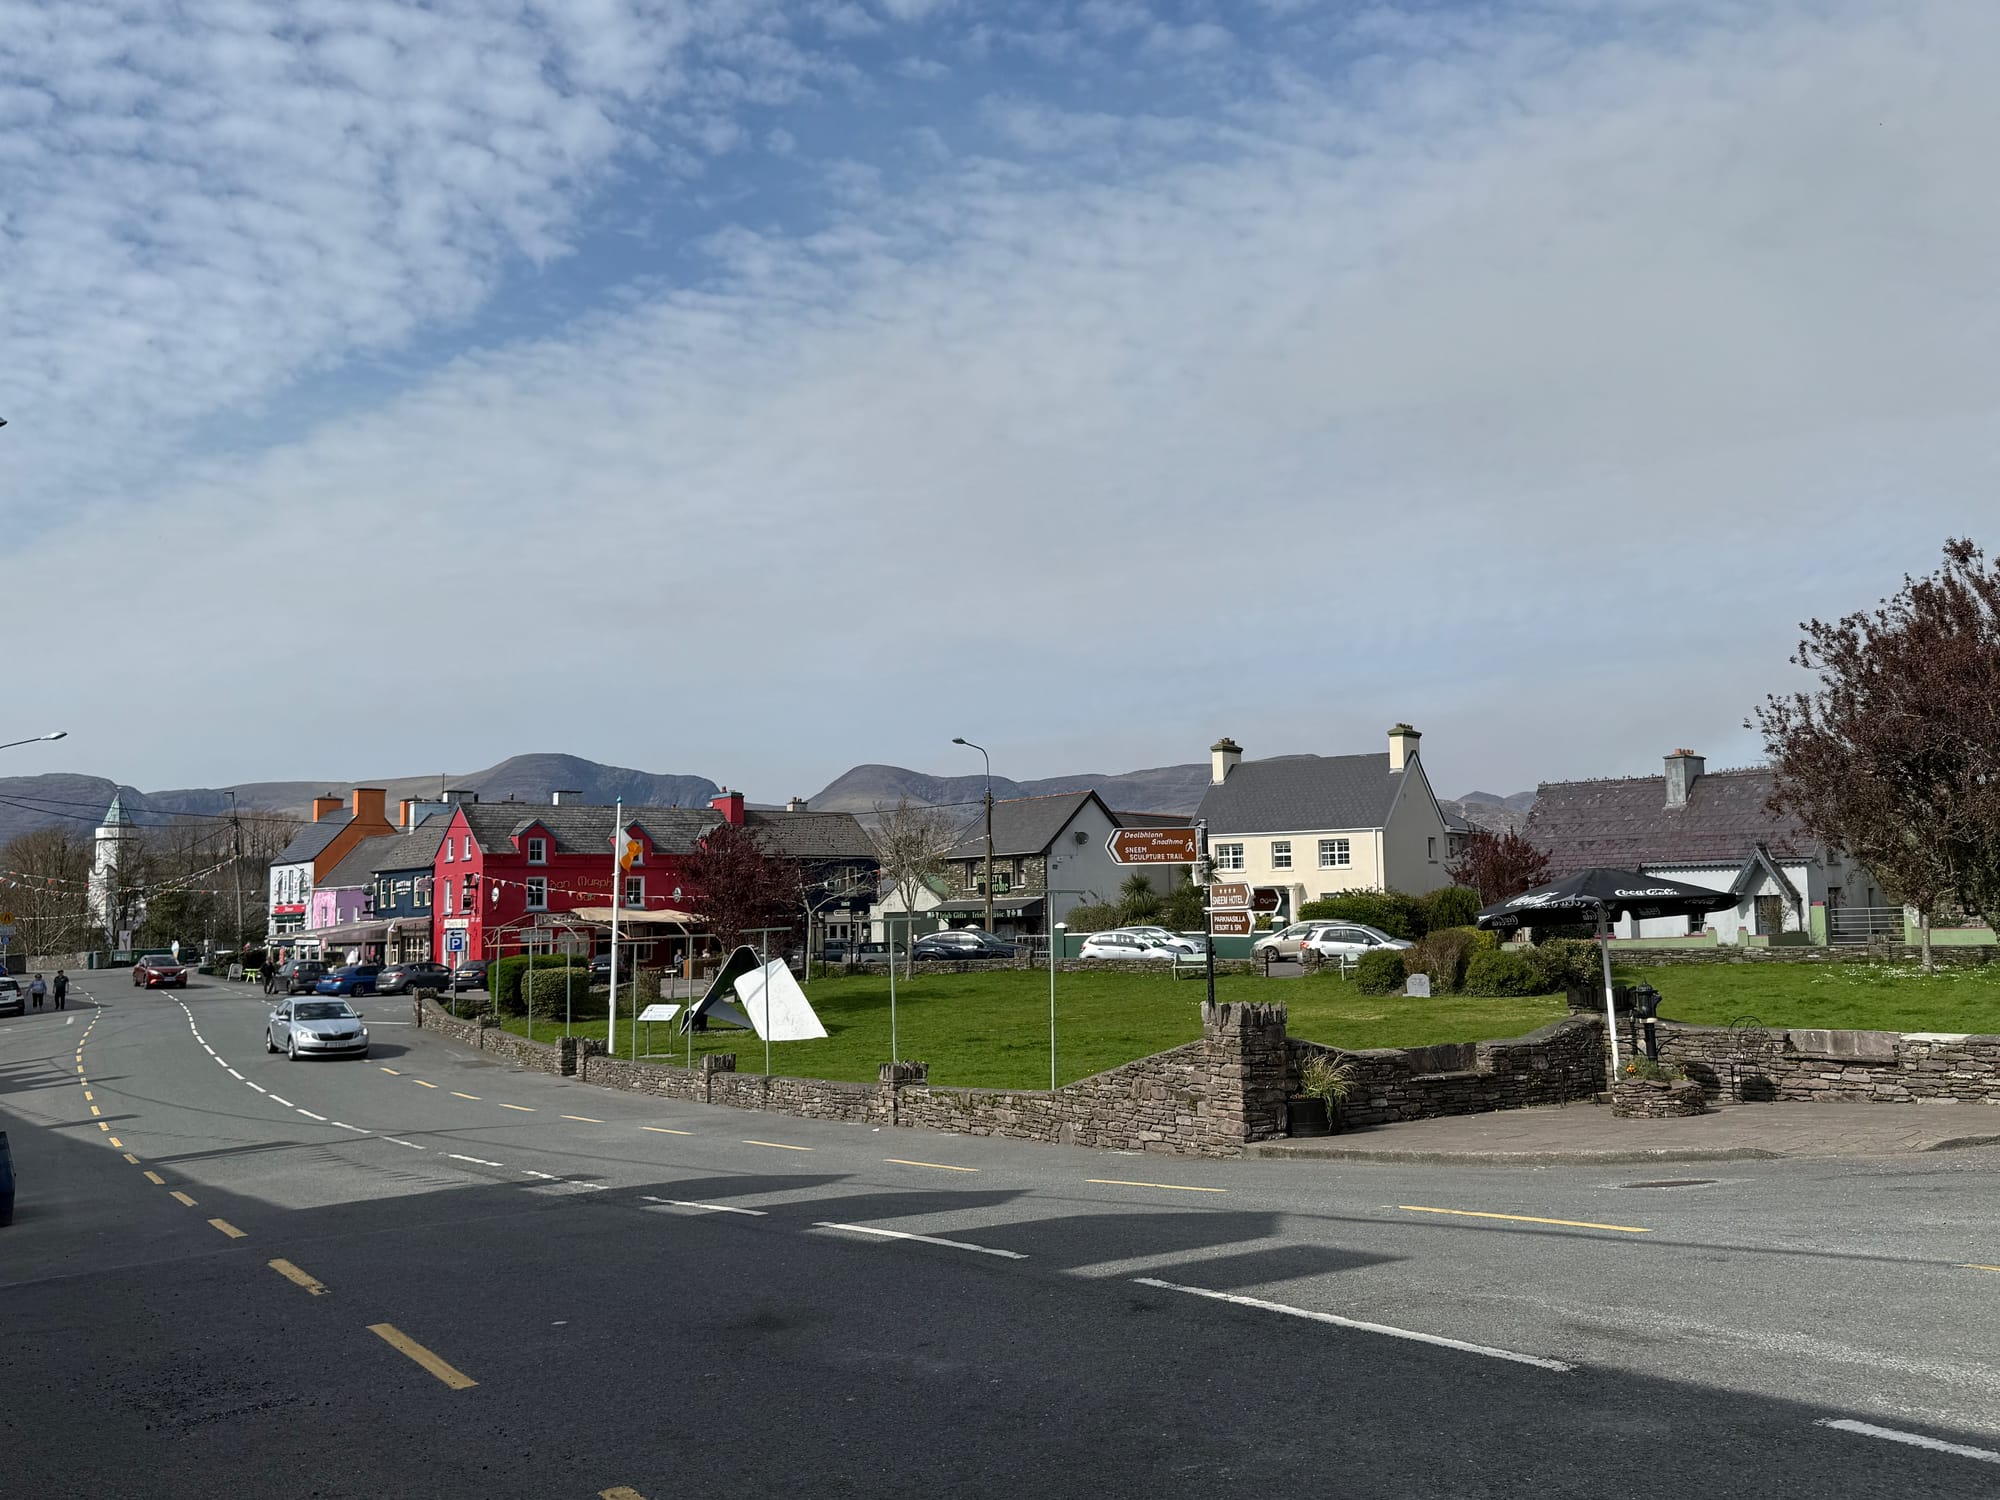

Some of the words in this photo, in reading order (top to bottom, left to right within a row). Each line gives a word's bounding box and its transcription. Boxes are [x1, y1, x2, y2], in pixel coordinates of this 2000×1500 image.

[1124, 846, 1147, 854] SNEEM
[1129, 853, 1165, 861] SCULPTURE
[1228, 895, 1244, 904] HOTEL
[1214, 915, 1246, 923] PARKNASILLA
[451, 938, 460, 949] P
